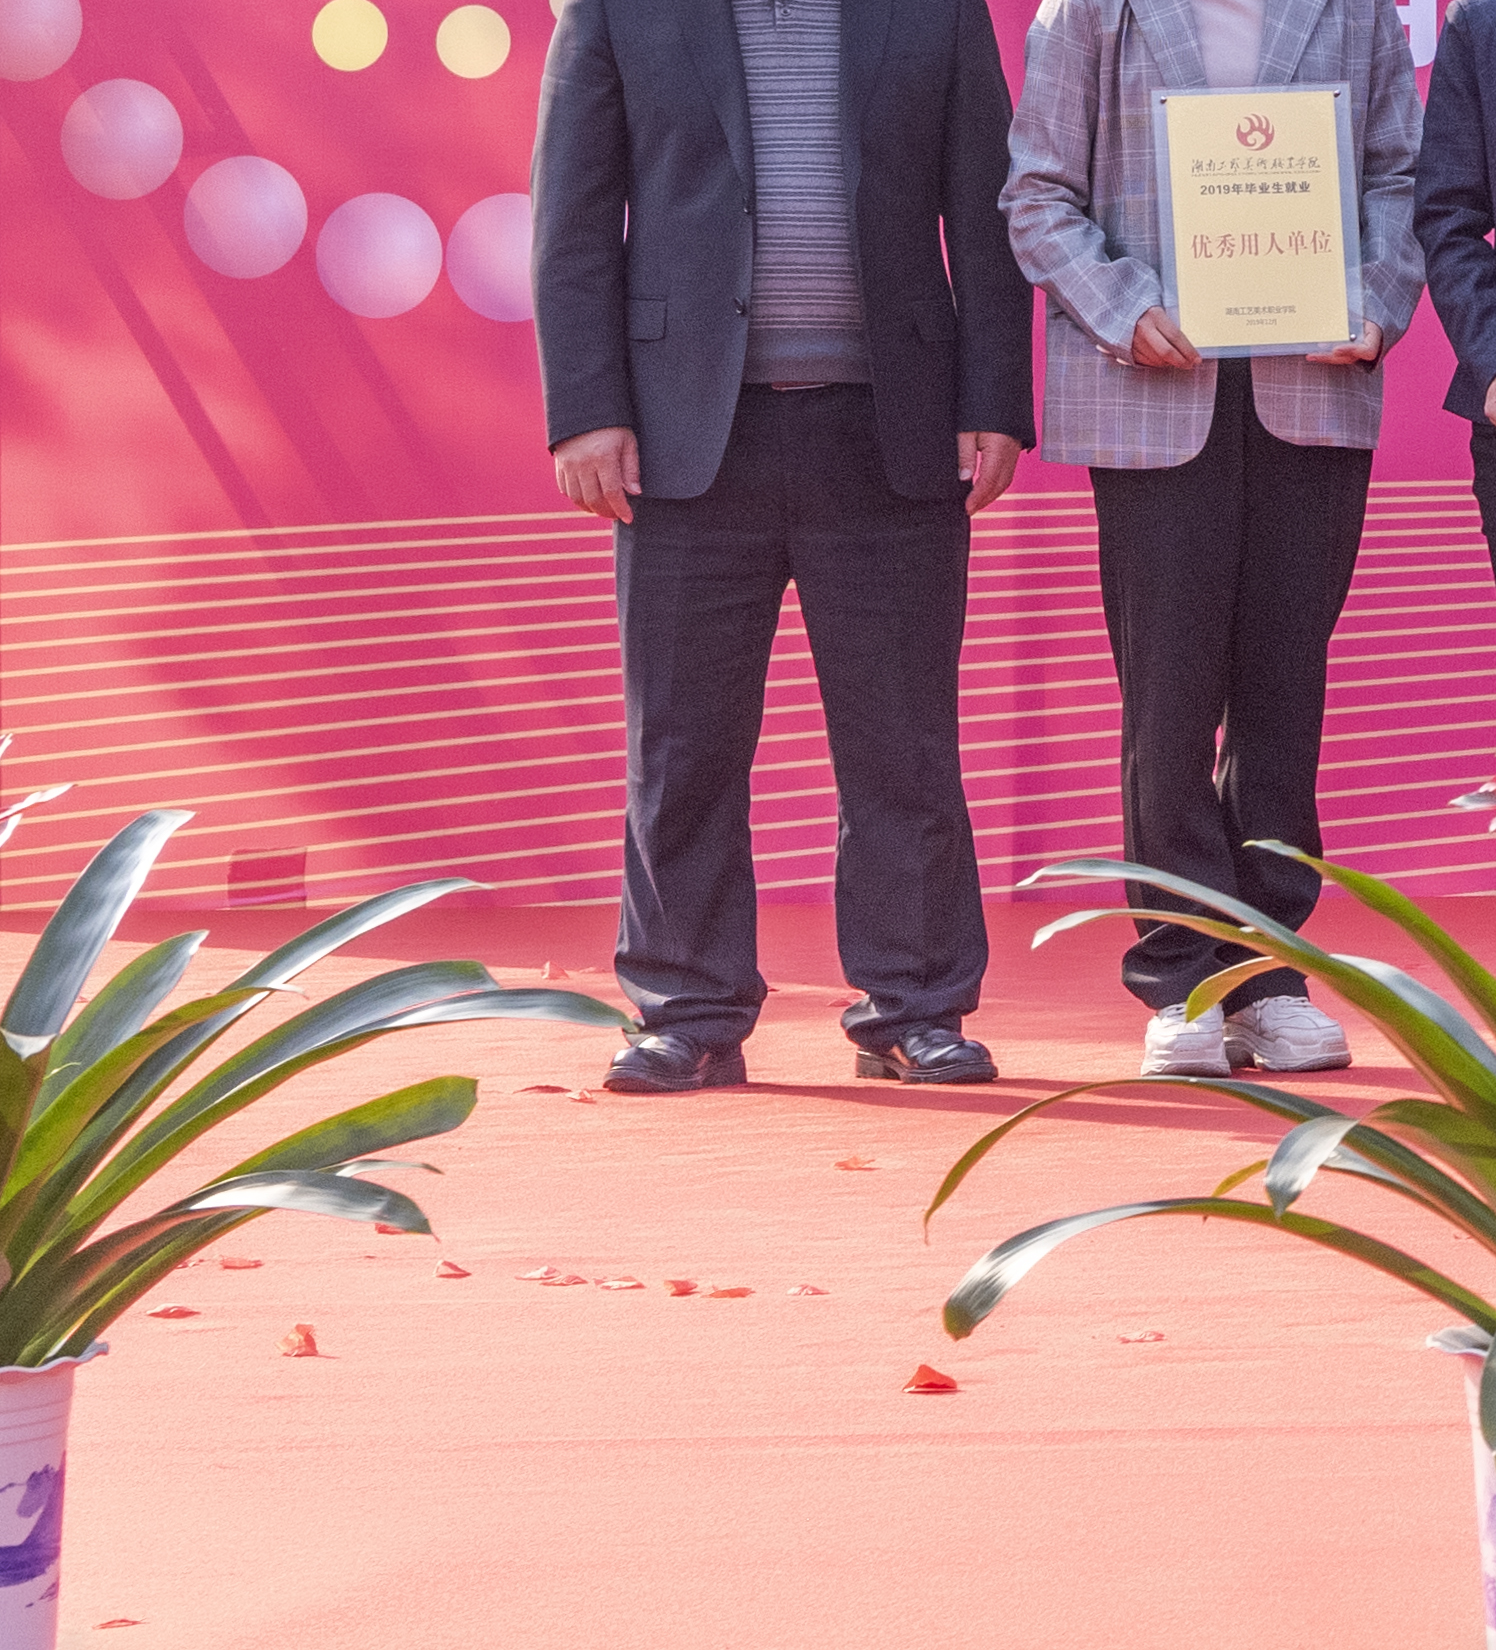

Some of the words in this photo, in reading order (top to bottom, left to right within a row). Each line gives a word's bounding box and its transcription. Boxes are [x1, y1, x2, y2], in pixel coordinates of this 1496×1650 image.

[1200, 181, 1311, 195] 2019年毕业生就业
[1191, 230, 1332, 259] 优秀用人单位
